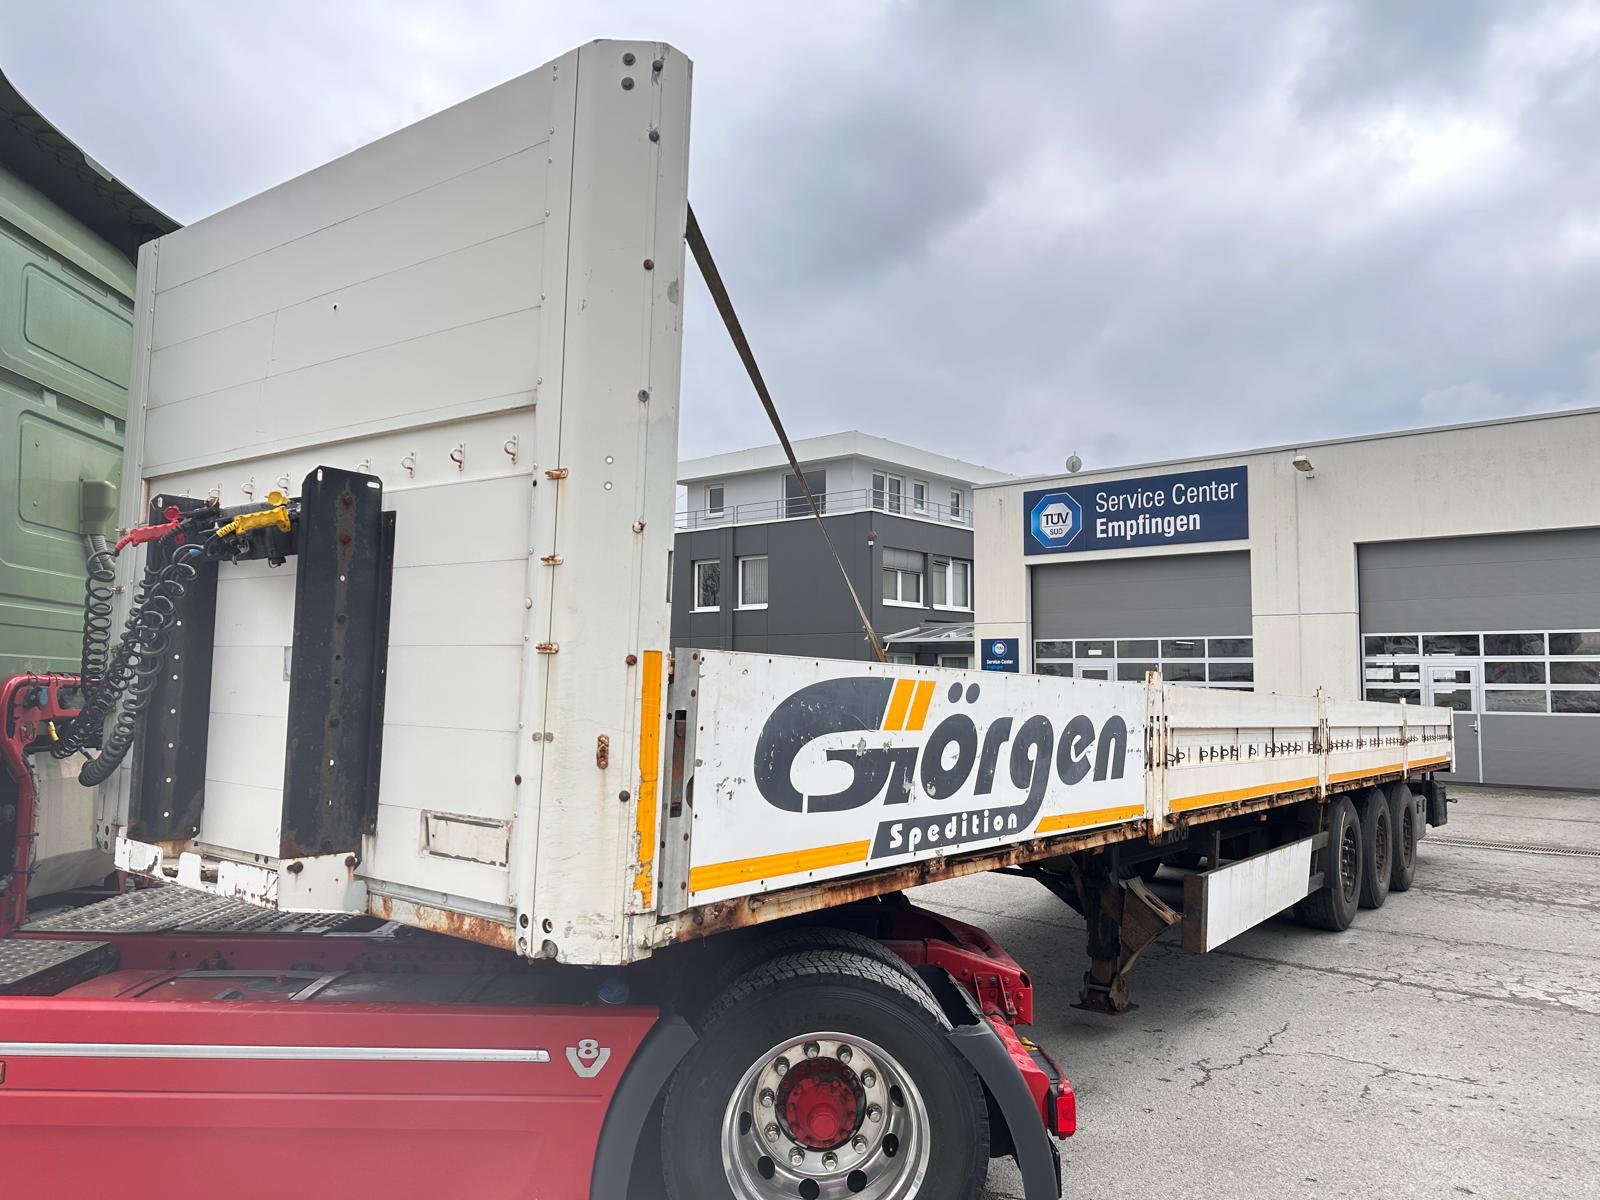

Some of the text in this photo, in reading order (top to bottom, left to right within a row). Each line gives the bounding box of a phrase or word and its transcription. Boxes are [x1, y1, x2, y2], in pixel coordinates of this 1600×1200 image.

[1095, 480, 1239, 513] Service Center
[1043, 511, 1069, 526] TÜV
[1096, 513, 1201, 541] Empfingen
[754, 676, 1127, 832] Görgen
[888, 811, 1019, 852] Spedition
